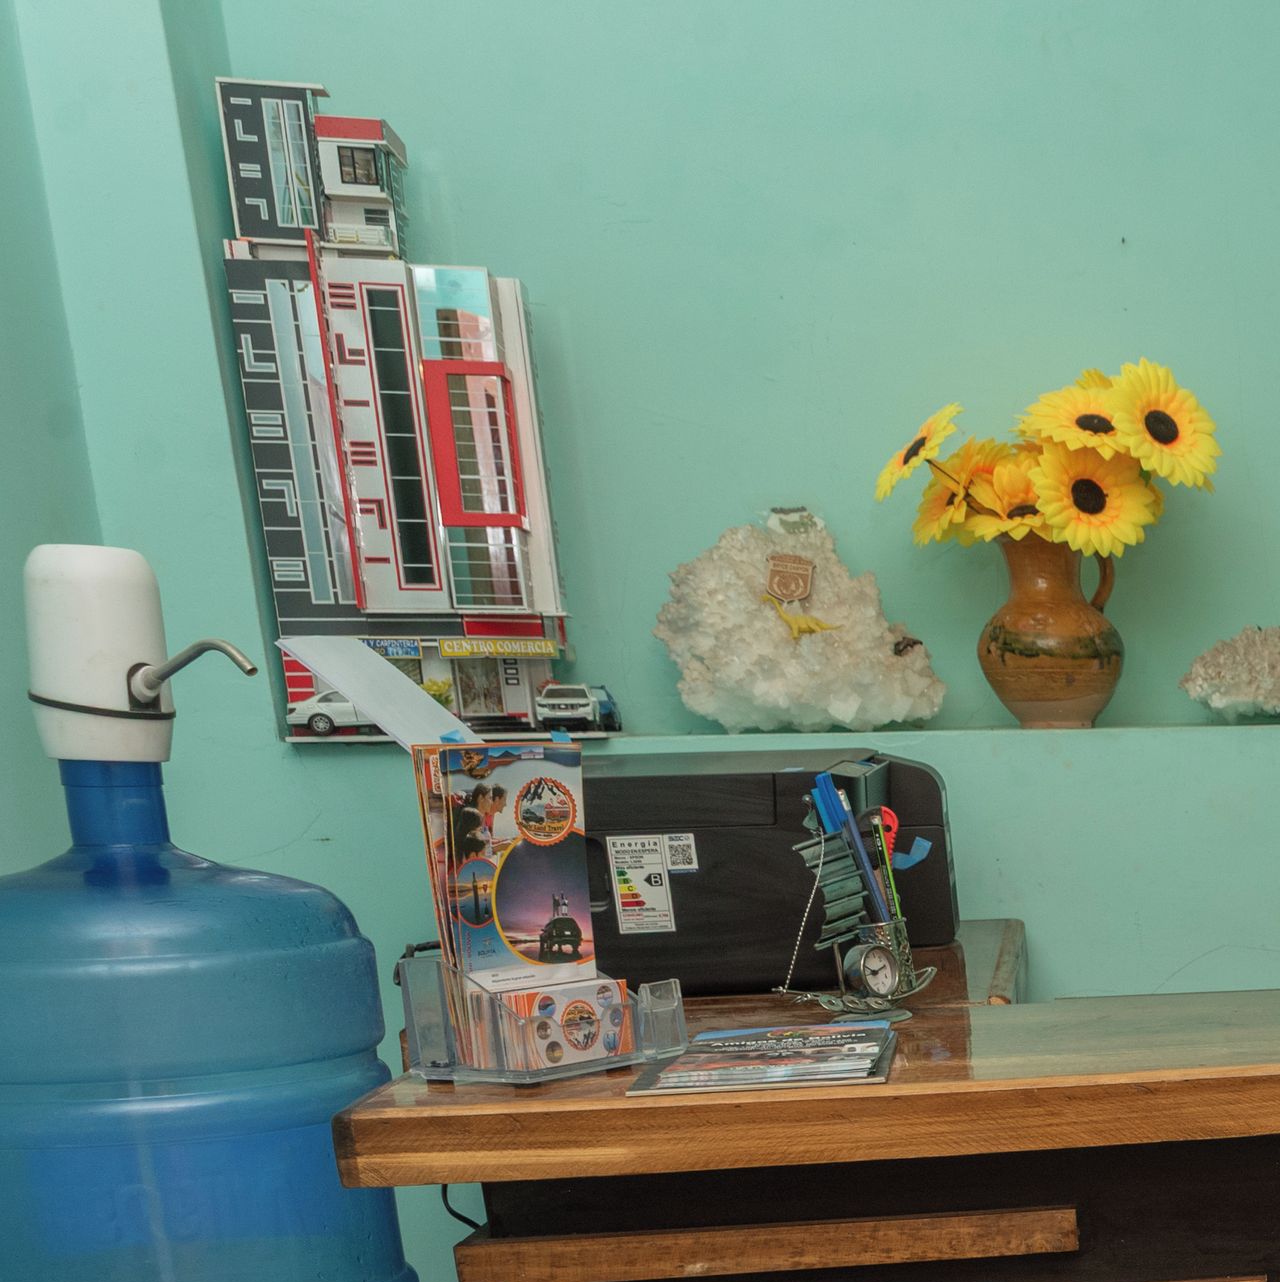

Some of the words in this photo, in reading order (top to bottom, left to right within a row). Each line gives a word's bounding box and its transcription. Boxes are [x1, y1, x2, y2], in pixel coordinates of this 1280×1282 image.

[443, 642, 494, 653] CENTRO
[496, 641, 554, 653] COMERCIA
[651, 874, 662, 886] B
